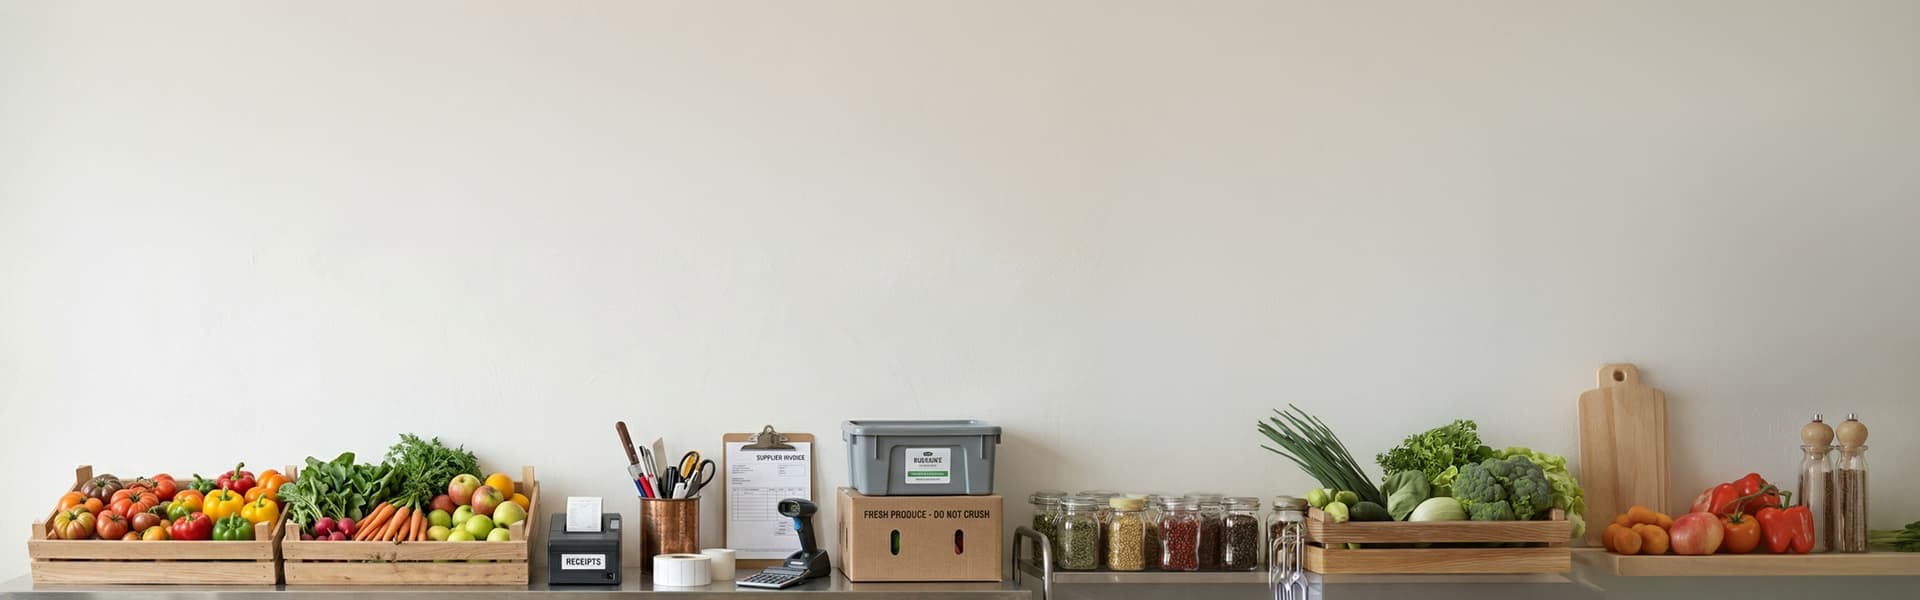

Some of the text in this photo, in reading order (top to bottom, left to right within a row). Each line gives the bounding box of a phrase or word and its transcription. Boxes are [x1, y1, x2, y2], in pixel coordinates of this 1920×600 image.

[864, 510, 888, 519] FRESH
[890, 510, 926, 519] PRODUCE
[933, 510, 944, 519] DO
[946, 510, 962, 519] NOT
[963, 510, 990, 519] CRUSH
[566, 558, 601, 566] RECEIPTS
